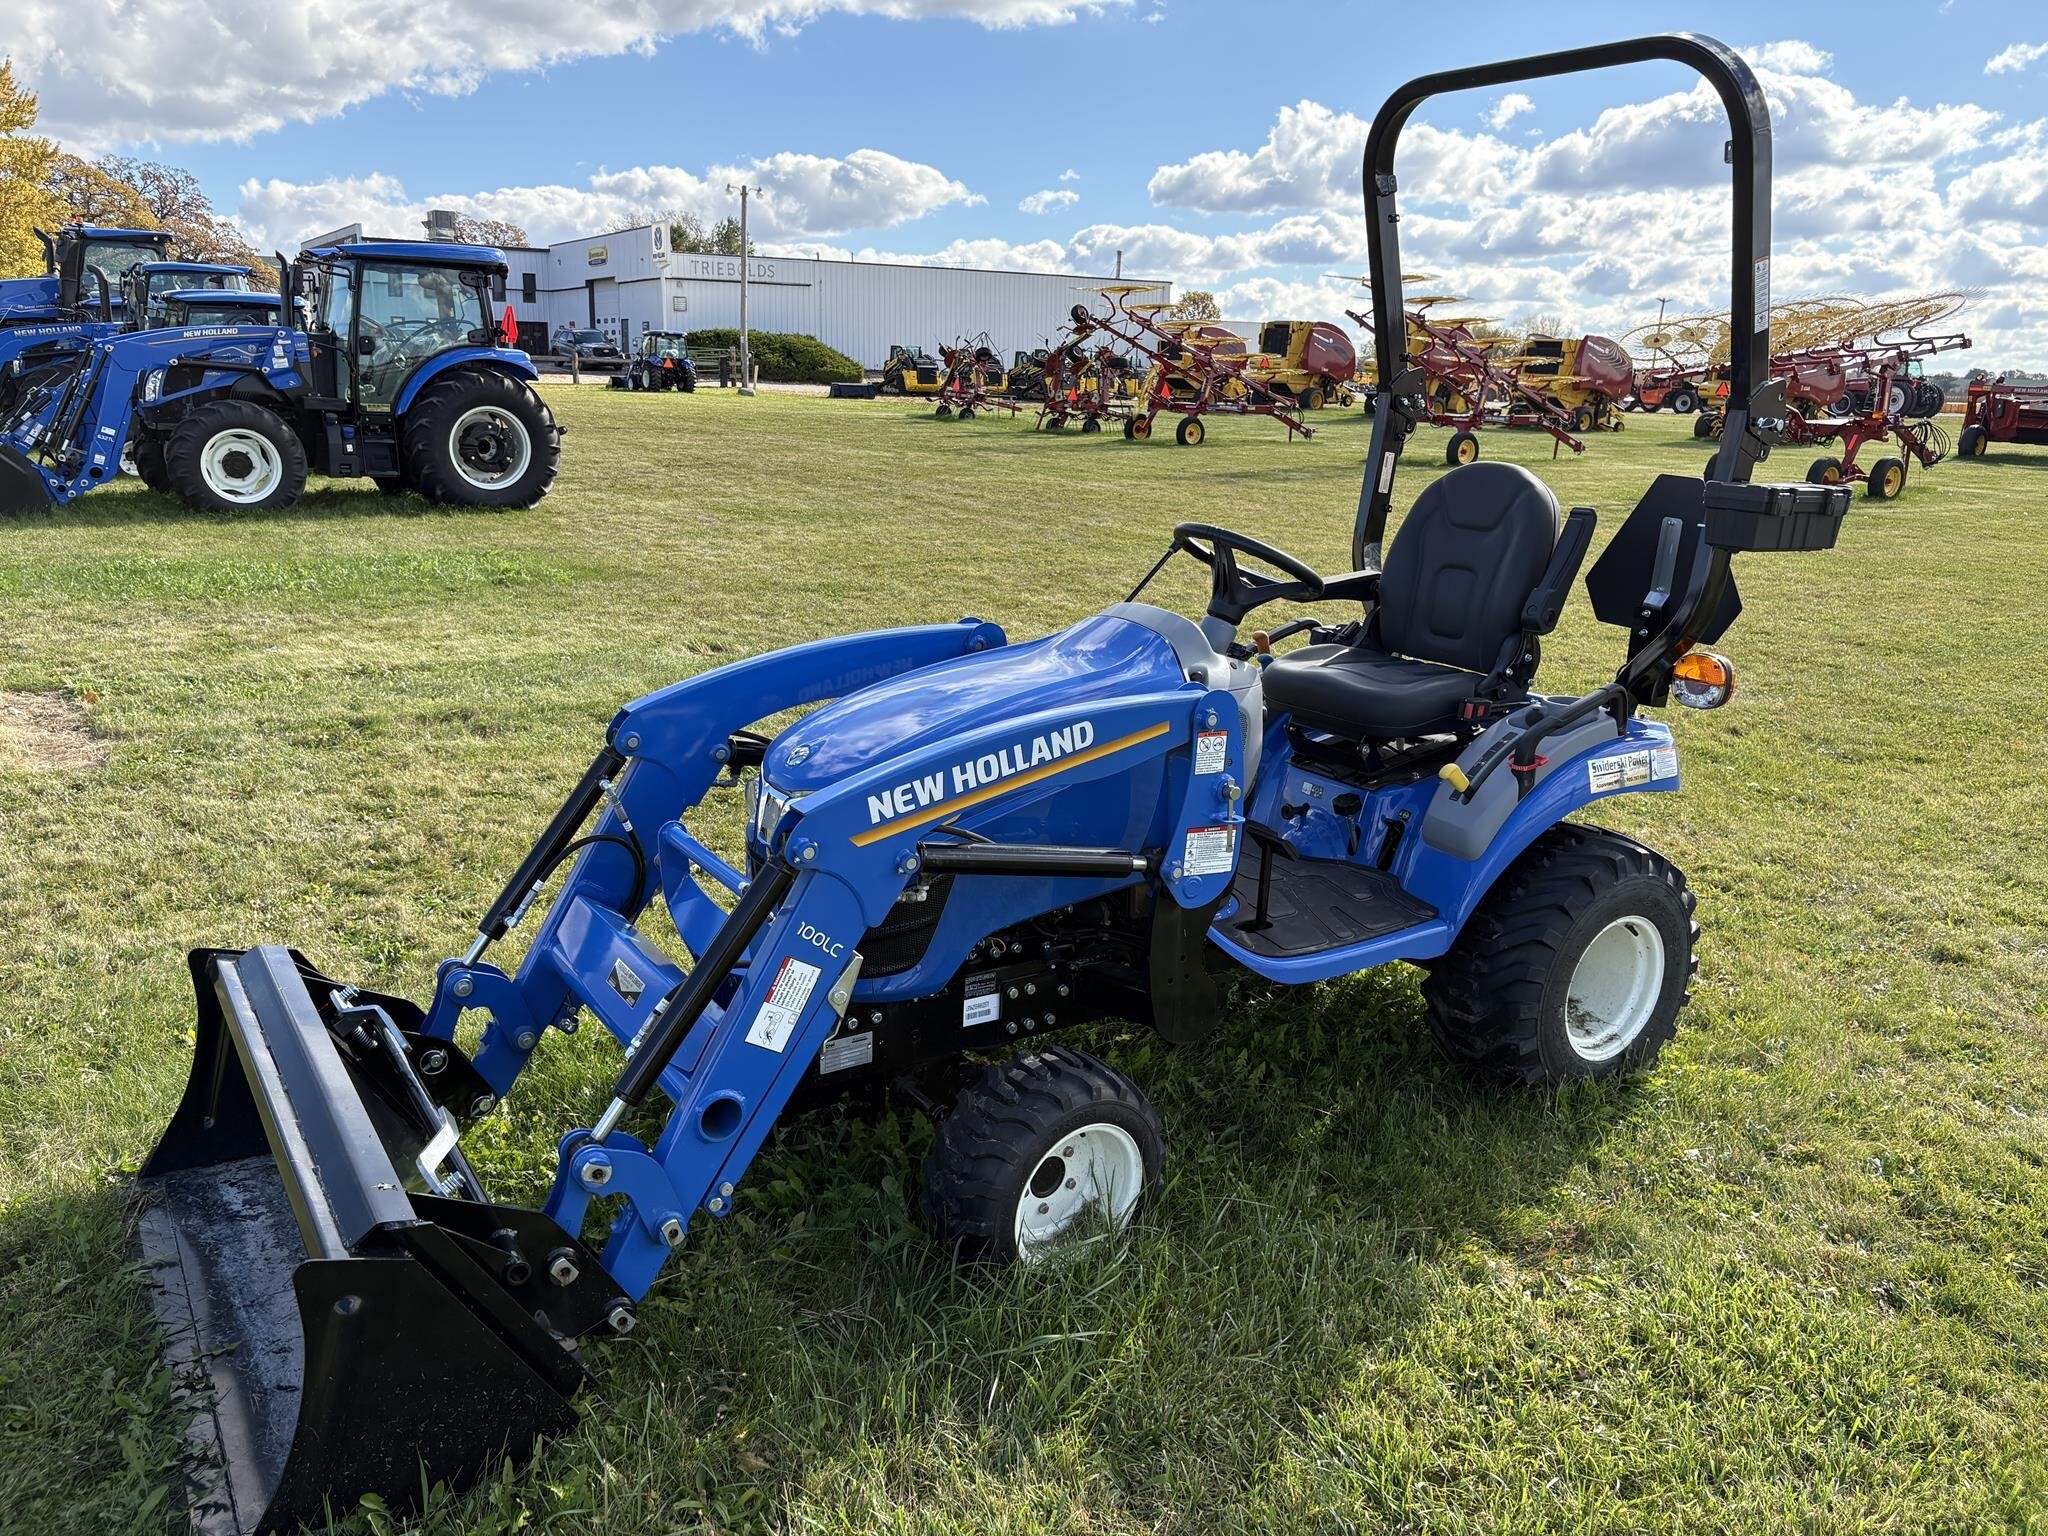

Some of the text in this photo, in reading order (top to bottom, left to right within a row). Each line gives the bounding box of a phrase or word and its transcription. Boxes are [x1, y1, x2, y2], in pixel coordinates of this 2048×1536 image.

[14, 325, 83, 338] NEW HOLLAND
[183, 327, 239, 338] NEW HOLLAND
[867, 720, 1095, 824] NEW HOLLAND
[796, 921, 844, 958] 100LC
